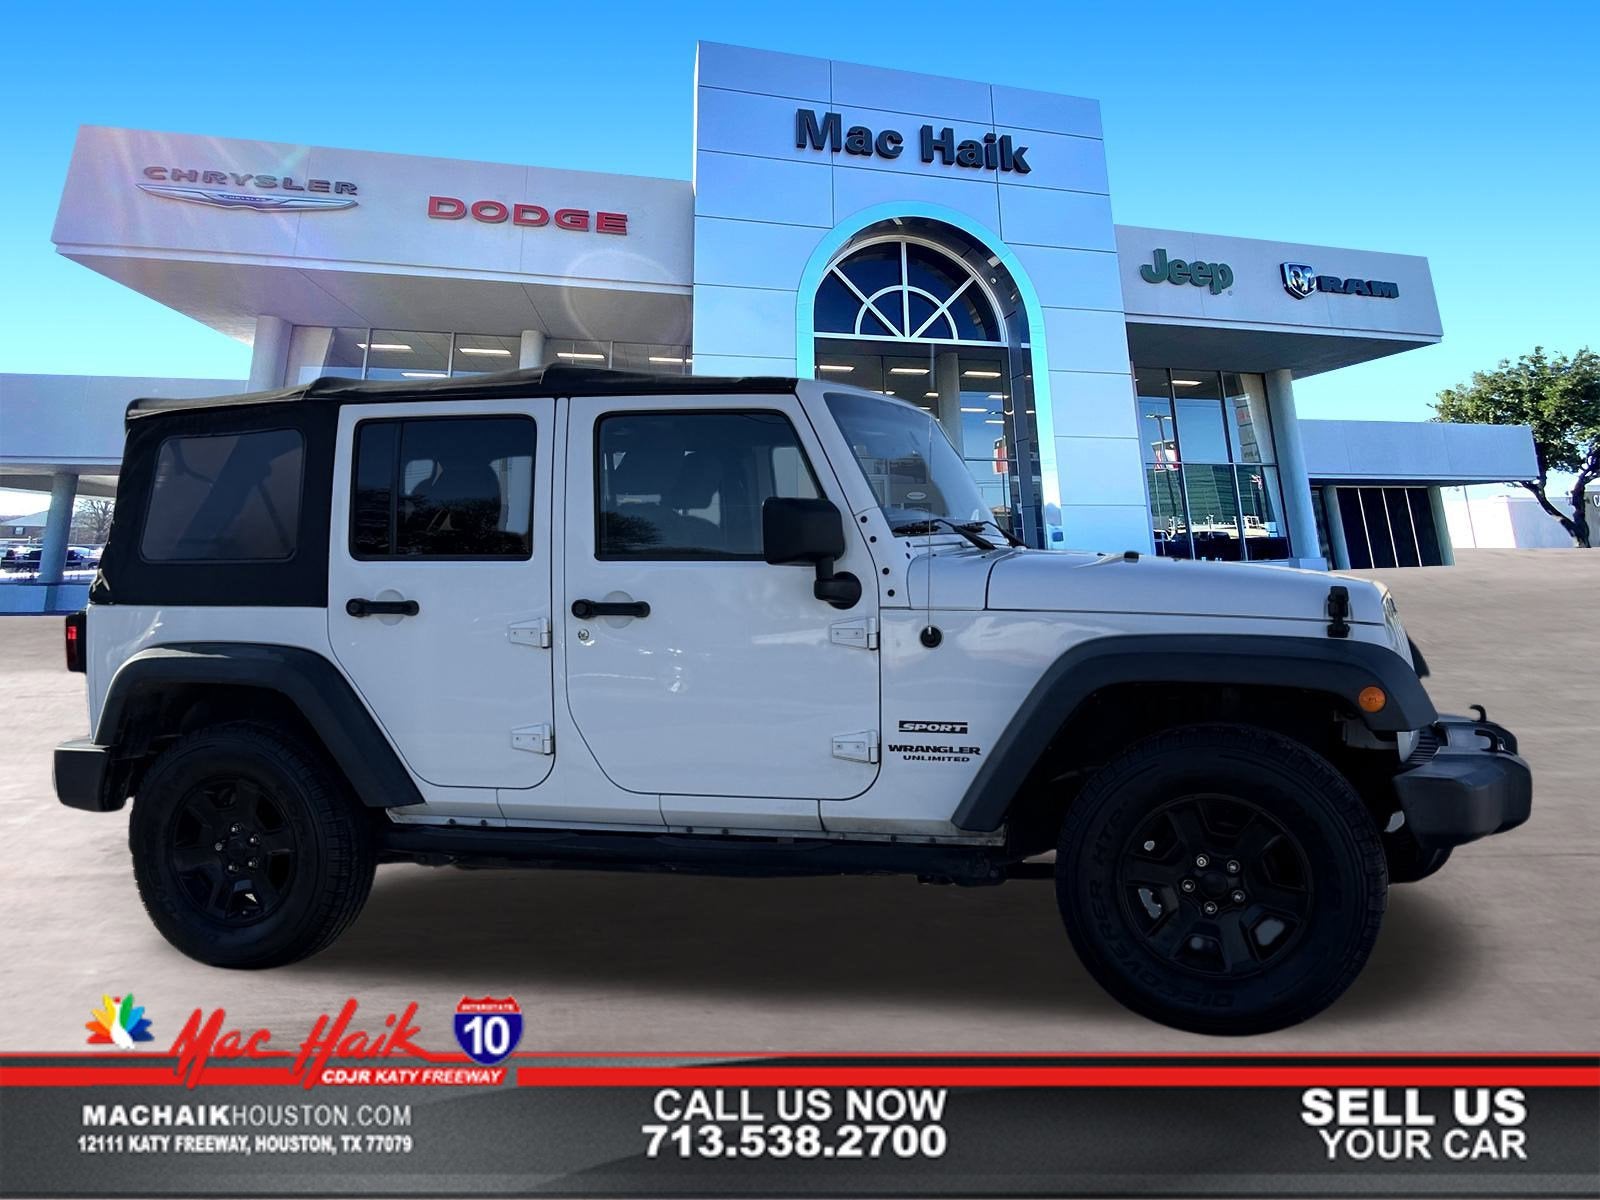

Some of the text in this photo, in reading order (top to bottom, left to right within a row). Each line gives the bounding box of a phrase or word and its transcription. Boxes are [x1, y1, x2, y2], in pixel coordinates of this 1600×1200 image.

[796, 108, 1032, 174] Mac Haik
[143, 166, 358, 196] CHRYSLER
[428, 196, 628, 236] DODGE
[1140, 248, 1234, 295] Jeep
[1316, 275, 1400, 299] RAM
[901, 722, 966, 733] SPORT
[888, 744, 981, 756] WRANGLER
[1089, 879, 1236, 1010] DISCOVERER
